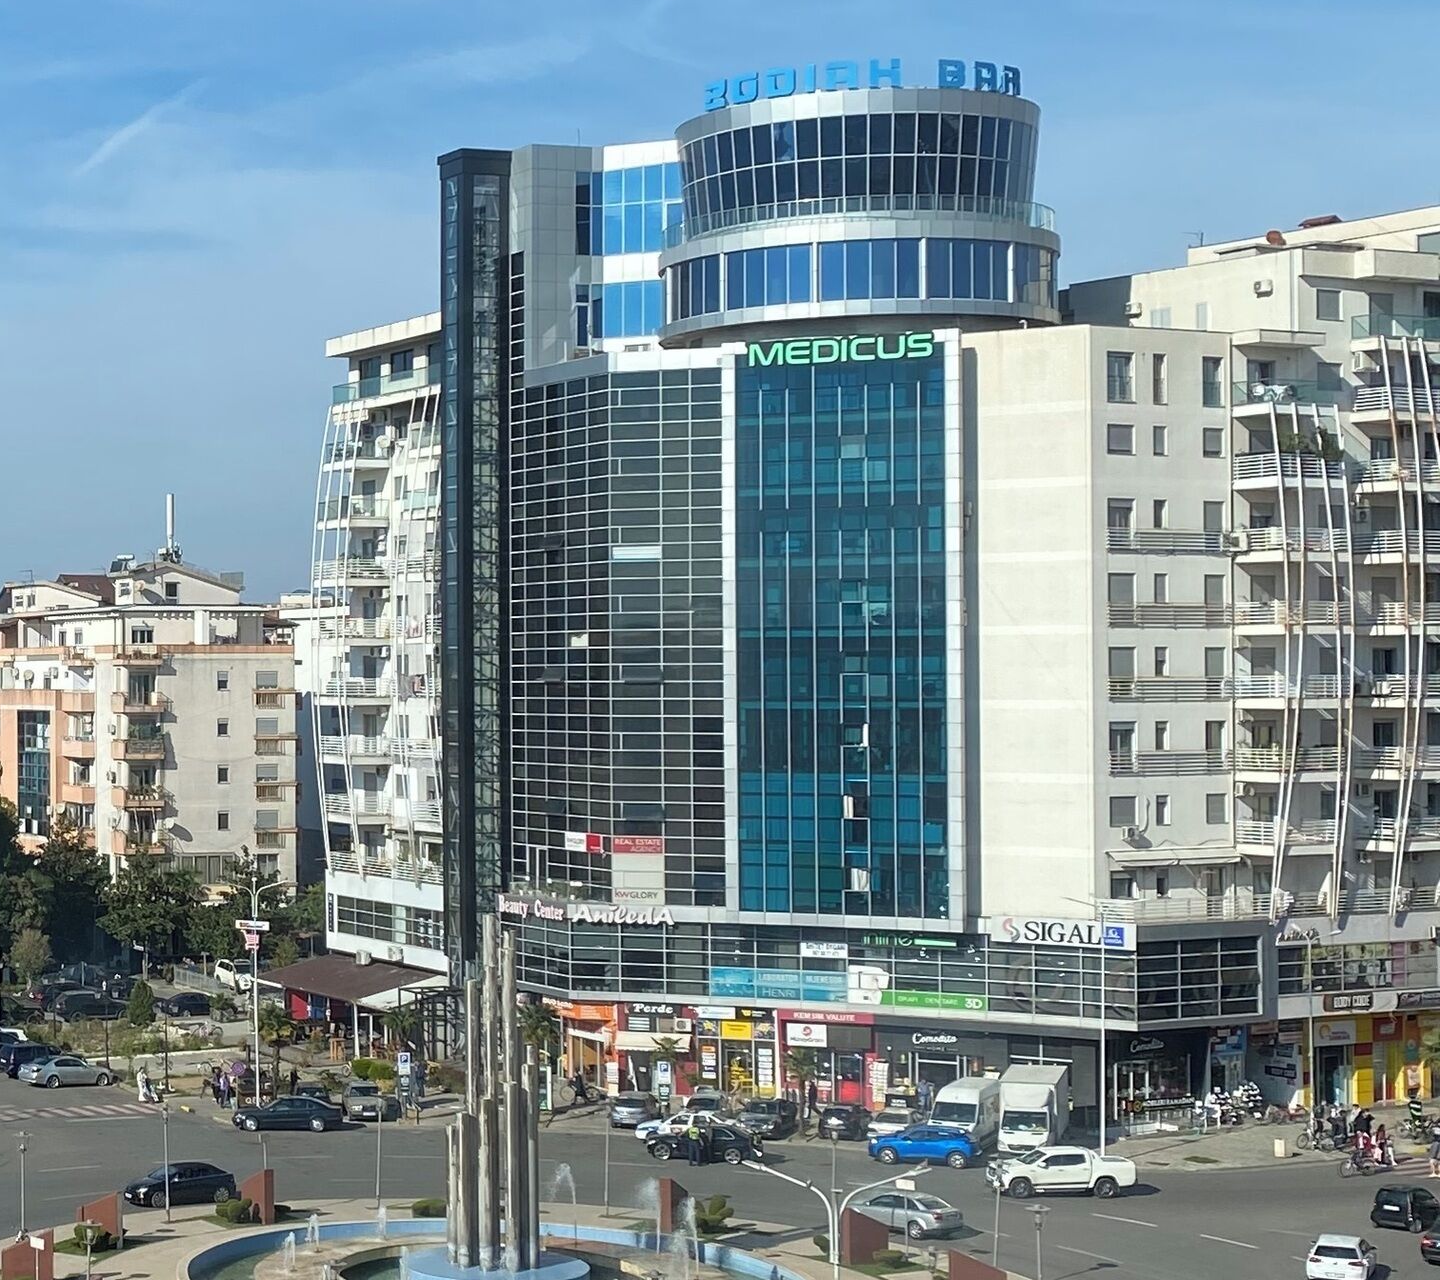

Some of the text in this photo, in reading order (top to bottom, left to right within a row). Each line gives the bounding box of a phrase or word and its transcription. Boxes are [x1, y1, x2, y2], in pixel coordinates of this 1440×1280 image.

[939, 58, 1022, 96] BAR
[748, 332, 934, 367] MEDICUS
[635, 838, 661, 846] ESTATE
[498, 894, 564, 921] Beauty Center
[1024, 920, 1101, 945] SIGAL
[762, 988, 796, 998] HENRI
[633, 1003, 673, 1014] Perde
[964, 998, 983, 1009] 3D
[825, 1013, 856, 1021] VALUTE
